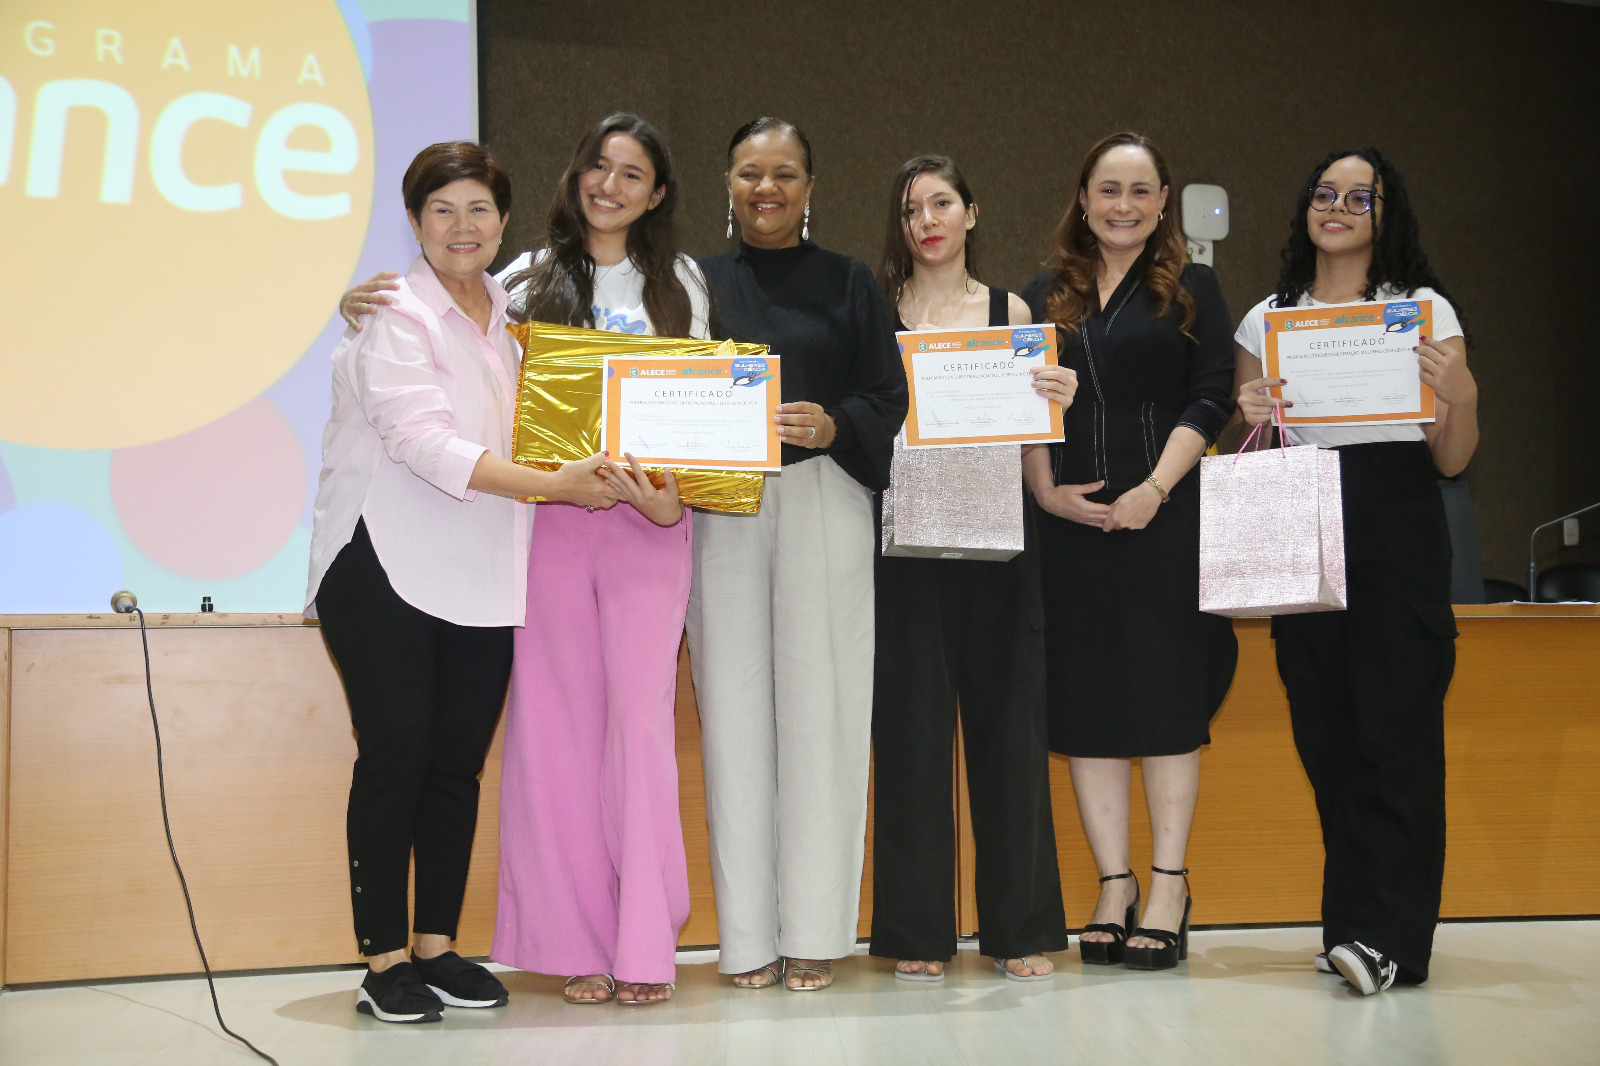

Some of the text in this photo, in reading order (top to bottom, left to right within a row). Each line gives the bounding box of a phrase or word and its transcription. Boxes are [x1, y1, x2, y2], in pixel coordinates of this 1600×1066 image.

[0, 72, 360, 220] nce
[1295, 319, 1319, 327] ALECE
[1335, 314, 1375, 324] alcance
[928, 342, 952, 350] ALECE
[966, 338, 1004, 348] alcance
[1309, 337, 1386, 350] CERTIFICADO
[681, 366, 723, 376] alcance
[943, 361, 1015, 372] CERTIFICADO
[654, 390, 733, 398] CERTIFICADO
